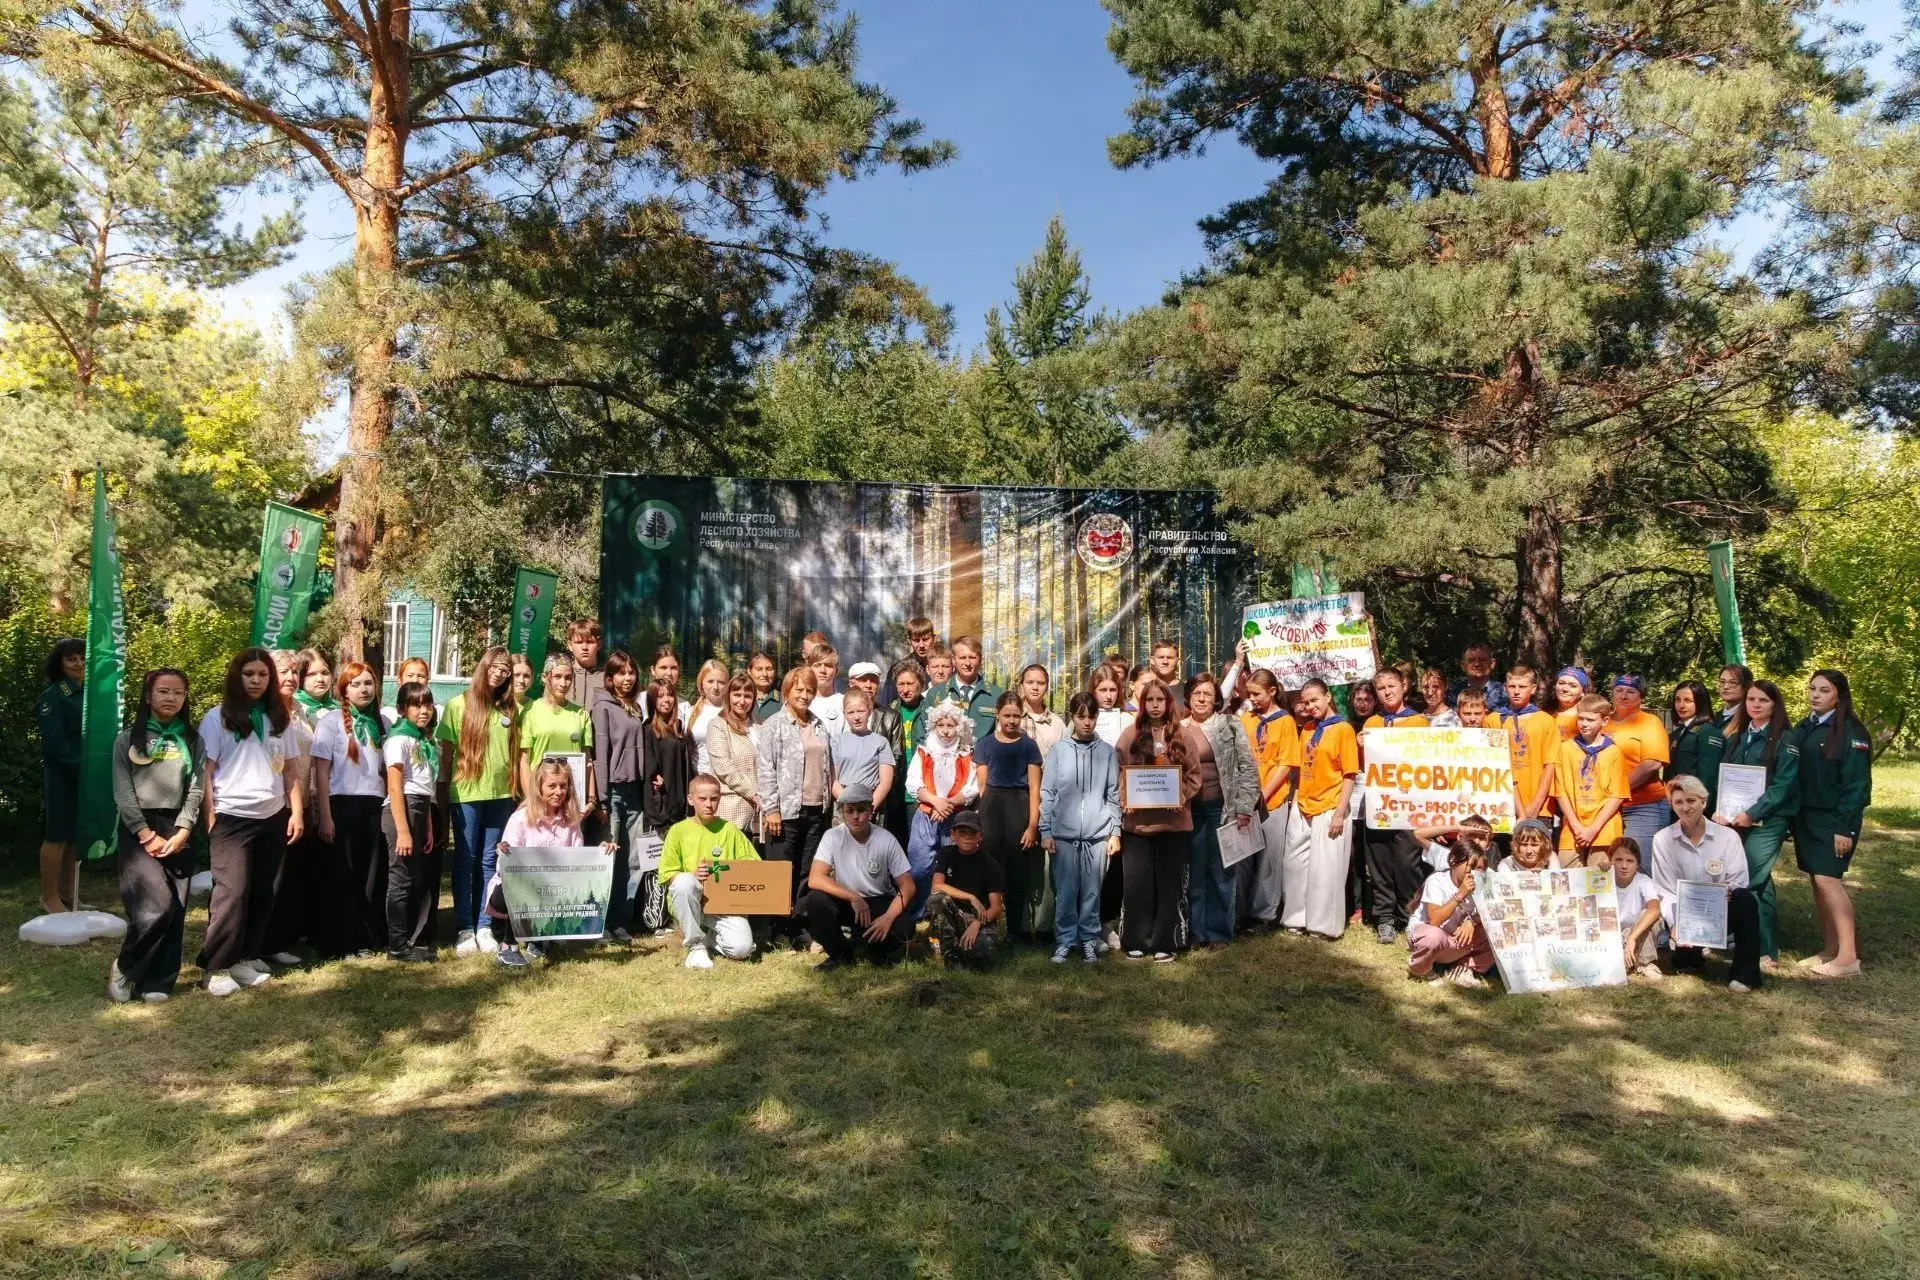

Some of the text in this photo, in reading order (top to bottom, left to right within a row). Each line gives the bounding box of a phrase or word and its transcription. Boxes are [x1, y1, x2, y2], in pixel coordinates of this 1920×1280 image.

[700, 511, 776, 524] МИНИСТЕРСТВО
[700, 524, 801, 539] ЛЕСНОГО ХОЗЯЙСТВА
[1149, 530, 1228, 541] ПРАВИТЕЛЬСТВО
[700, 537, 790, 550] Республики Хакасия
[1149, 544, 1237, 556] Республики Хакасия
[1365, 763, 1514, 794] ЛЕСОВИЧОК
[729, 883, 766, 892] DEXP
